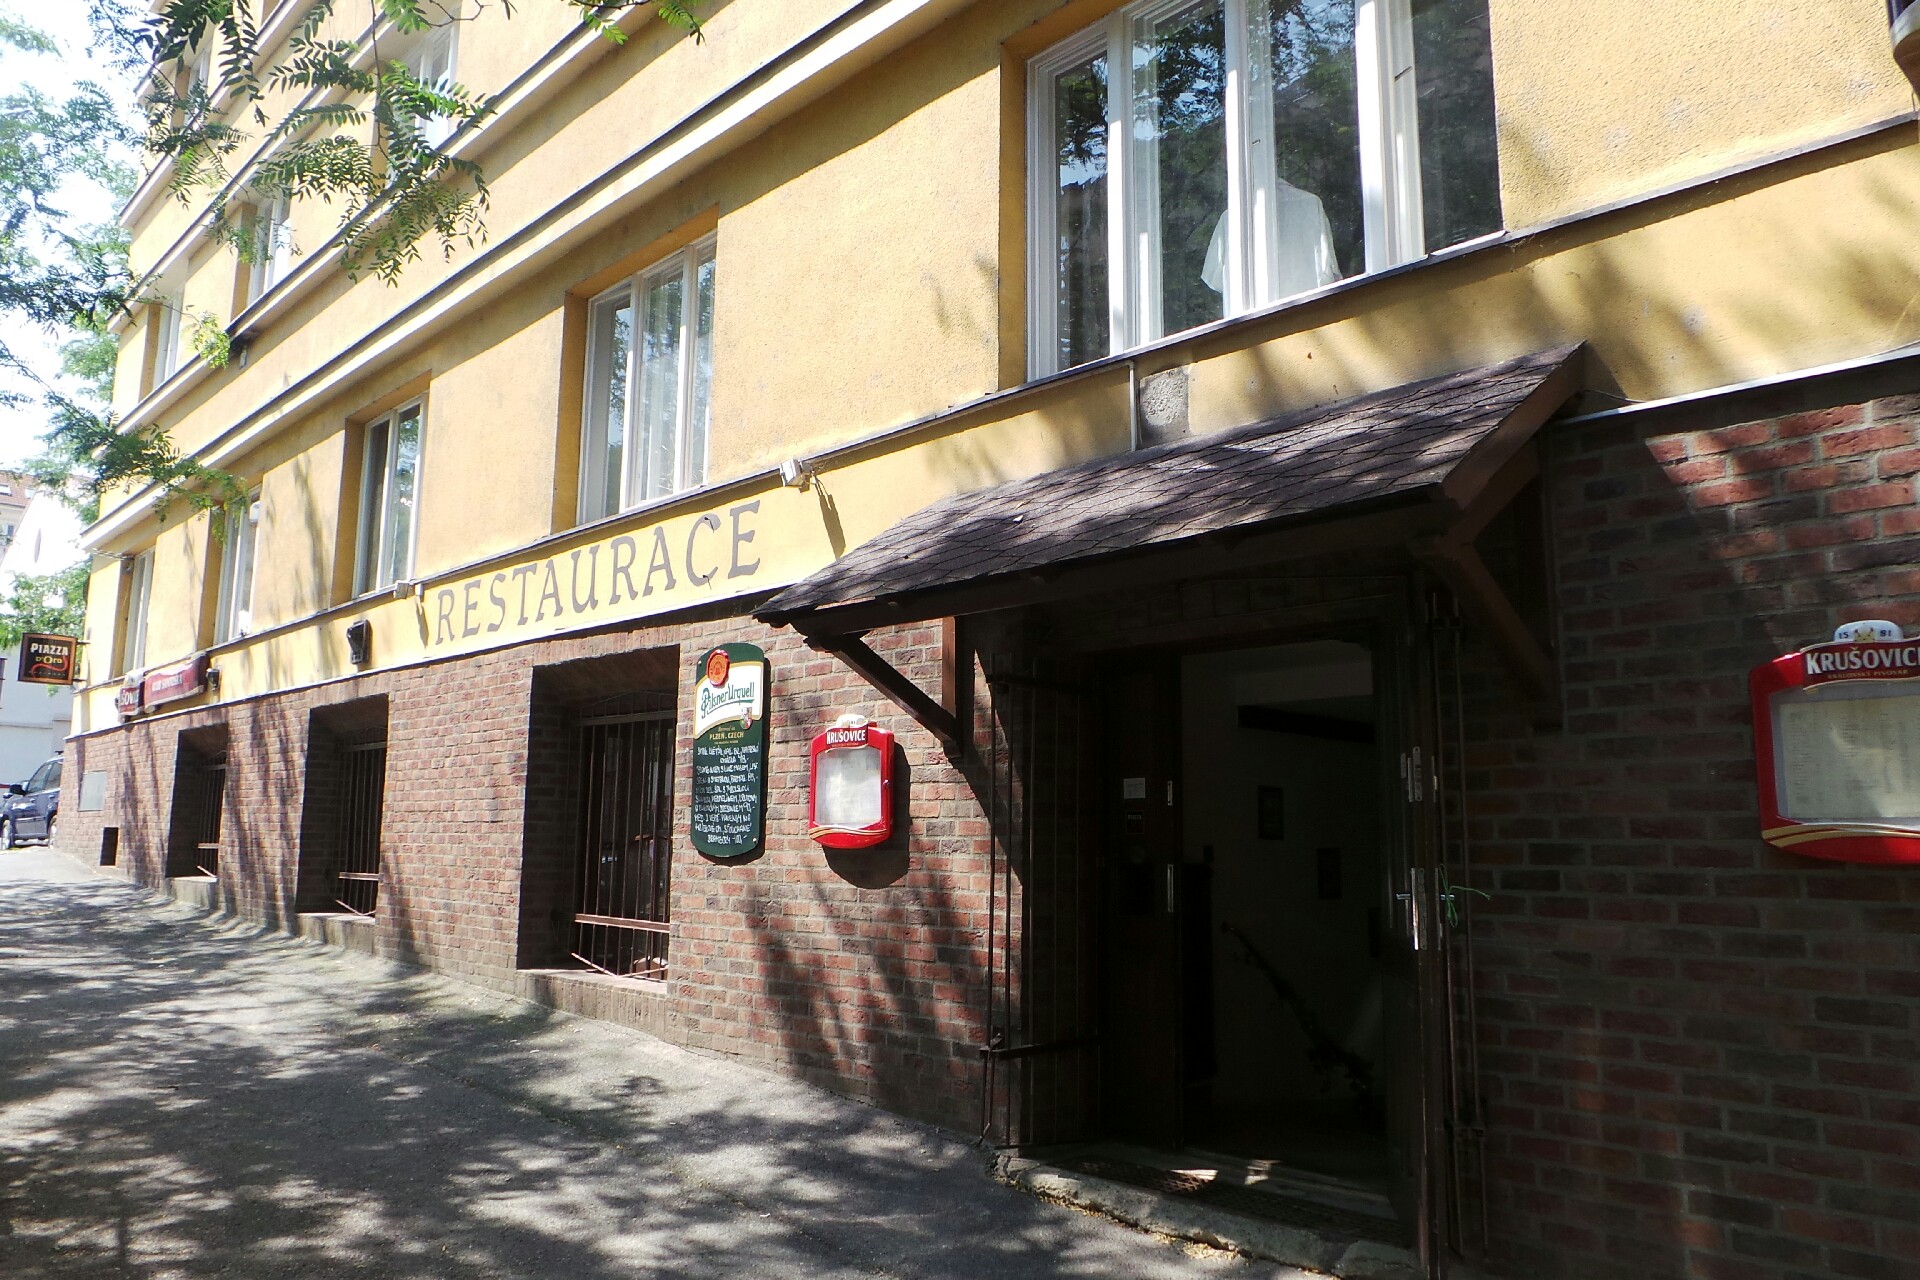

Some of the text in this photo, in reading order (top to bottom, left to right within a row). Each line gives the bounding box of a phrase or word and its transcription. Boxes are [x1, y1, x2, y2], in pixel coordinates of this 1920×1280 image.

[435, 500, 762, 646] RESTAURACE
[30, 642, 69, 656] PIAZZA
[727, 681, 755, 706] Urquell
[826, 729, 866, 745] KRUŠOVICE
